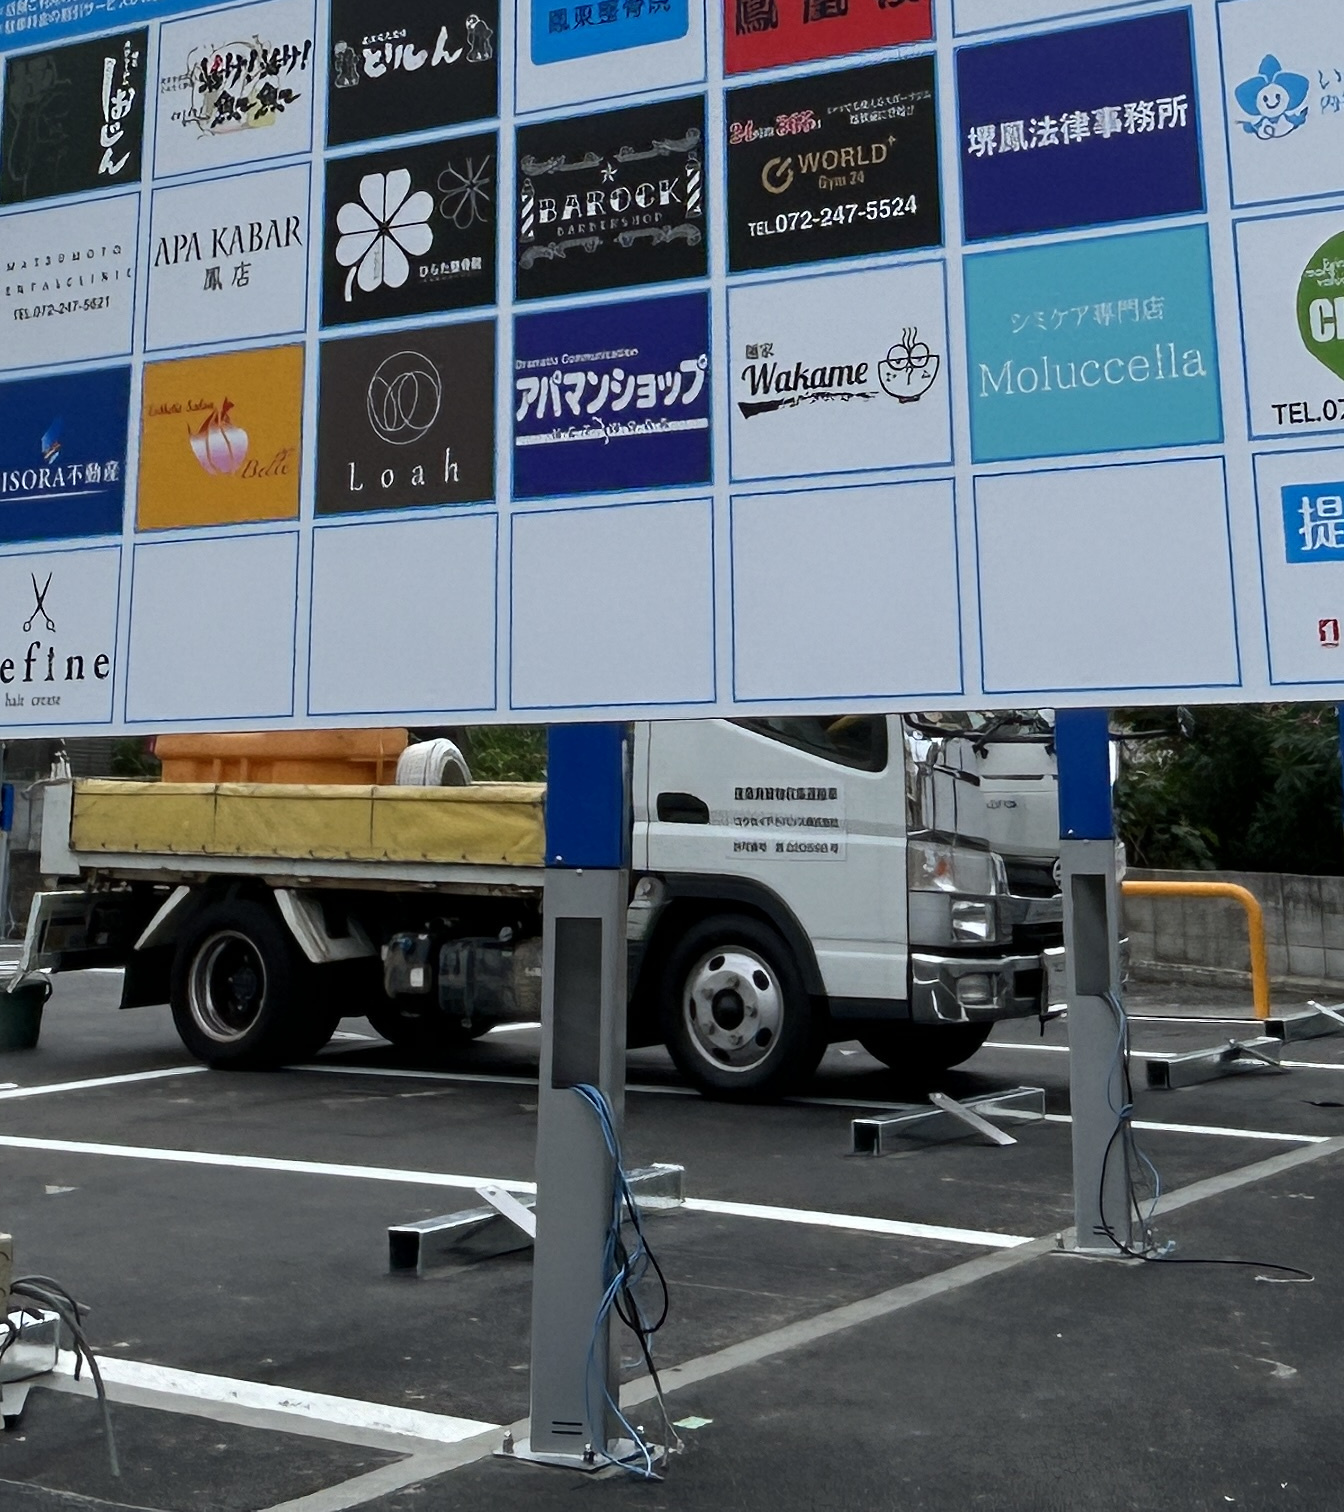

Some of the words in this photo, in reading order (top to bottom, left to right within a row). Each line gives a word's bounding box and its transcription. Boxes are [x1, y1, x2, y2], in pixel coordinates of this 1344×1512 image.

[968, 94, 1188, 157] 堺鳳法律事務所
[538, 177, 682, 224] BAROCK
[154, 232, 202, 267] APA
[212, 215, 304, 260] KABAR
[516, 353, 708, 422] アパマンショップ
[741, 361, 869, 396] Wakame
[979, 342, 1207, 397] Moluccella
[348, 447, 461, 492] Loah
